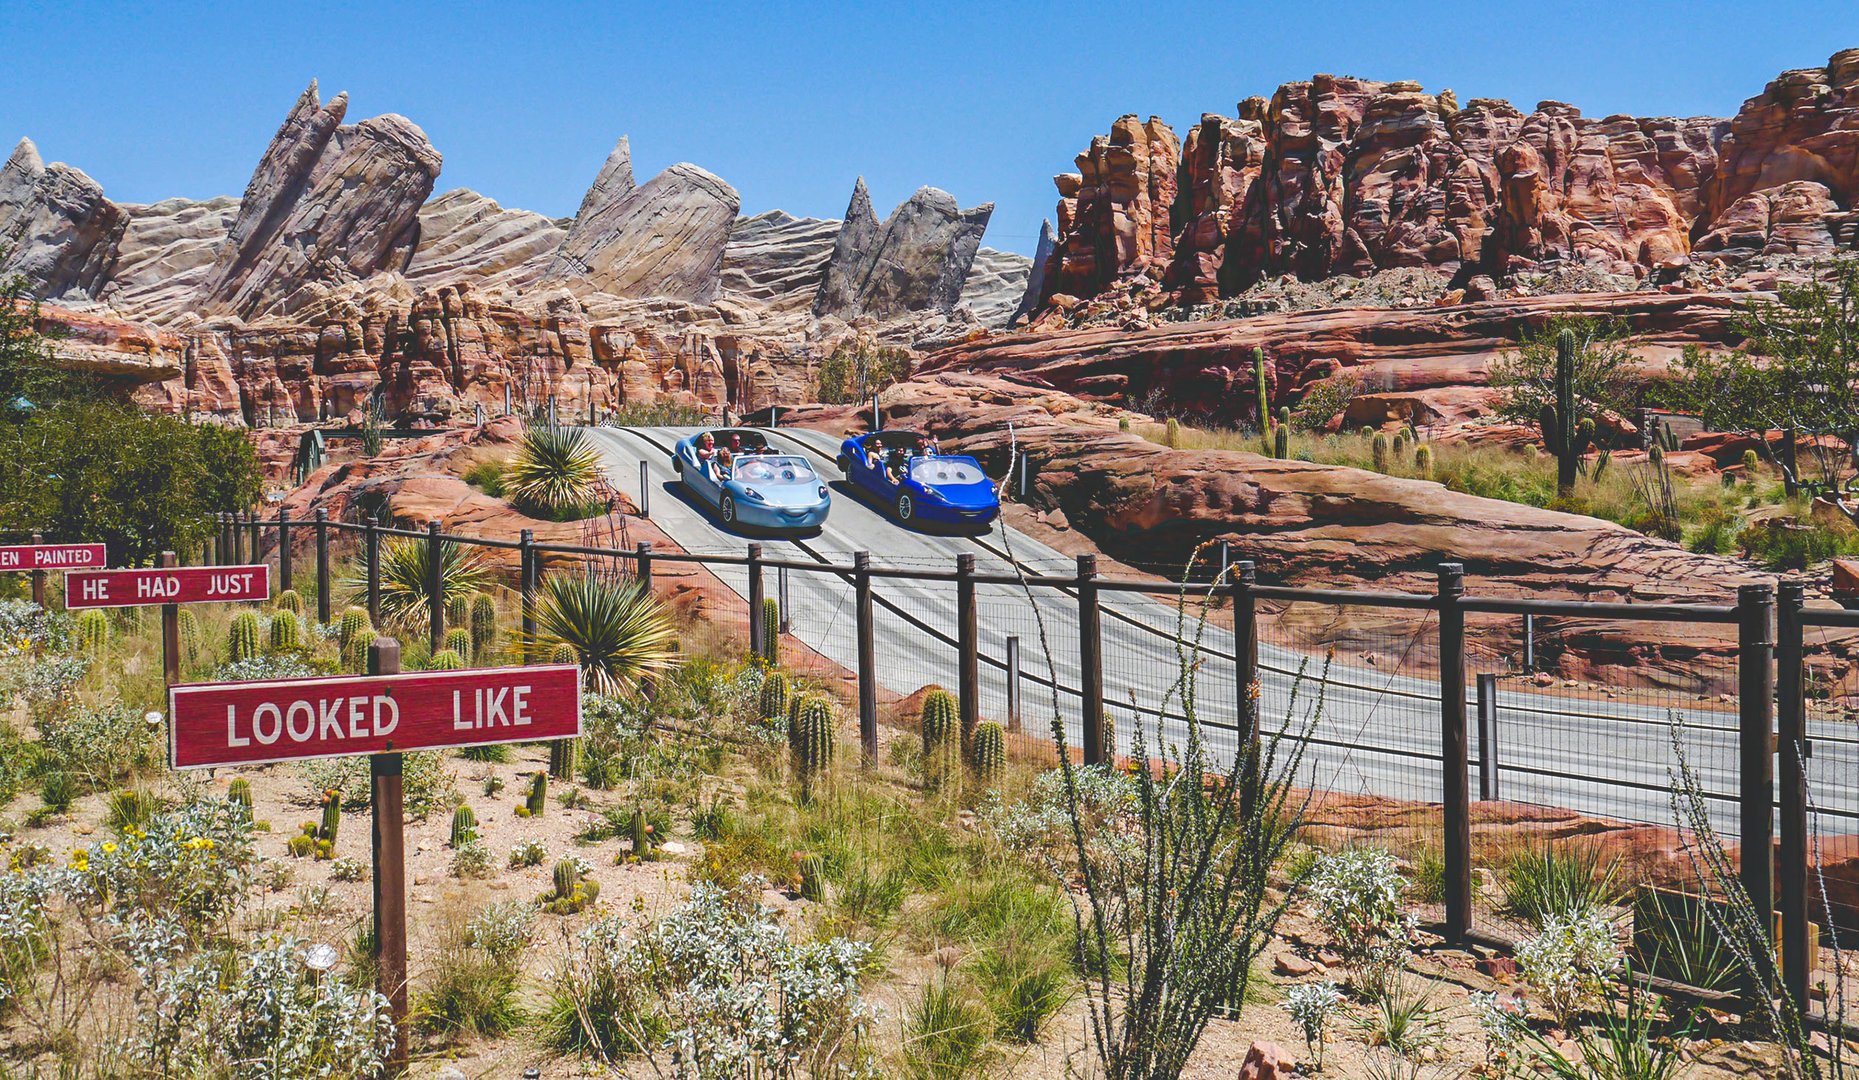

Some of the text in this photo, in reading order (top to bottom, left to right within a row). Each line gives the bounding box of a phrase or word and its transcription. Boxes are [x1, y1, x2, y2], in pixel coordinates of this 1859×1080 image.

[0, 549, 92, 566] EN PAINTED
[83, 573, 254, 600] HE HAD JUST
[227, 685, 532, 748] LOOKED LIKE
